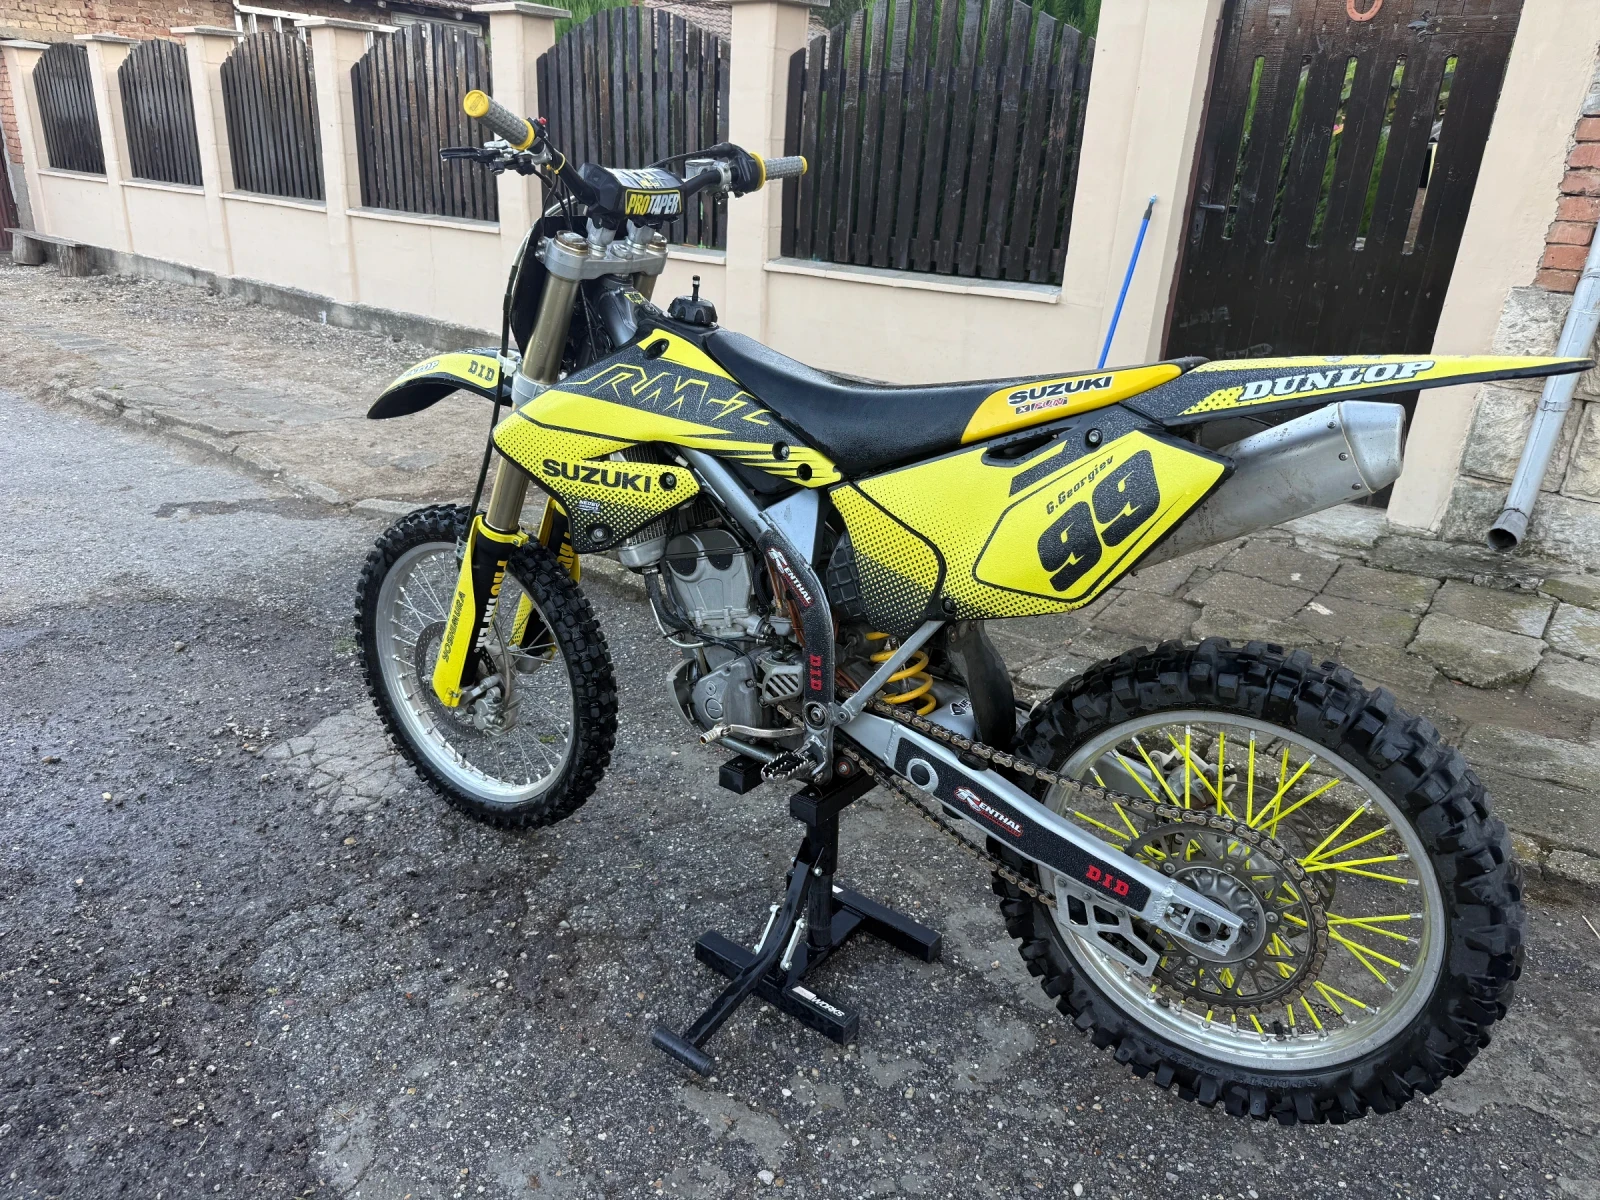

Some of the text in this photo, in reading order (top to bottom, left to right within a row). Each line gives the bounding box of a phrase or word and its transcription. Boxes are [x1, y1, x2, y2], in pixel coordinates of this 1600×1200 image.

[627, 193, 679, 216] PROTAPER
[1008, 376, 1113, 405] SUZUKI
[1236, 360, 1436, 402] DUNLOP
[542, 459, 652, 493] SUZUKI
[1037, 449, 1161, 592] 99
[955, 788, 1021, 833] RENTHAL
